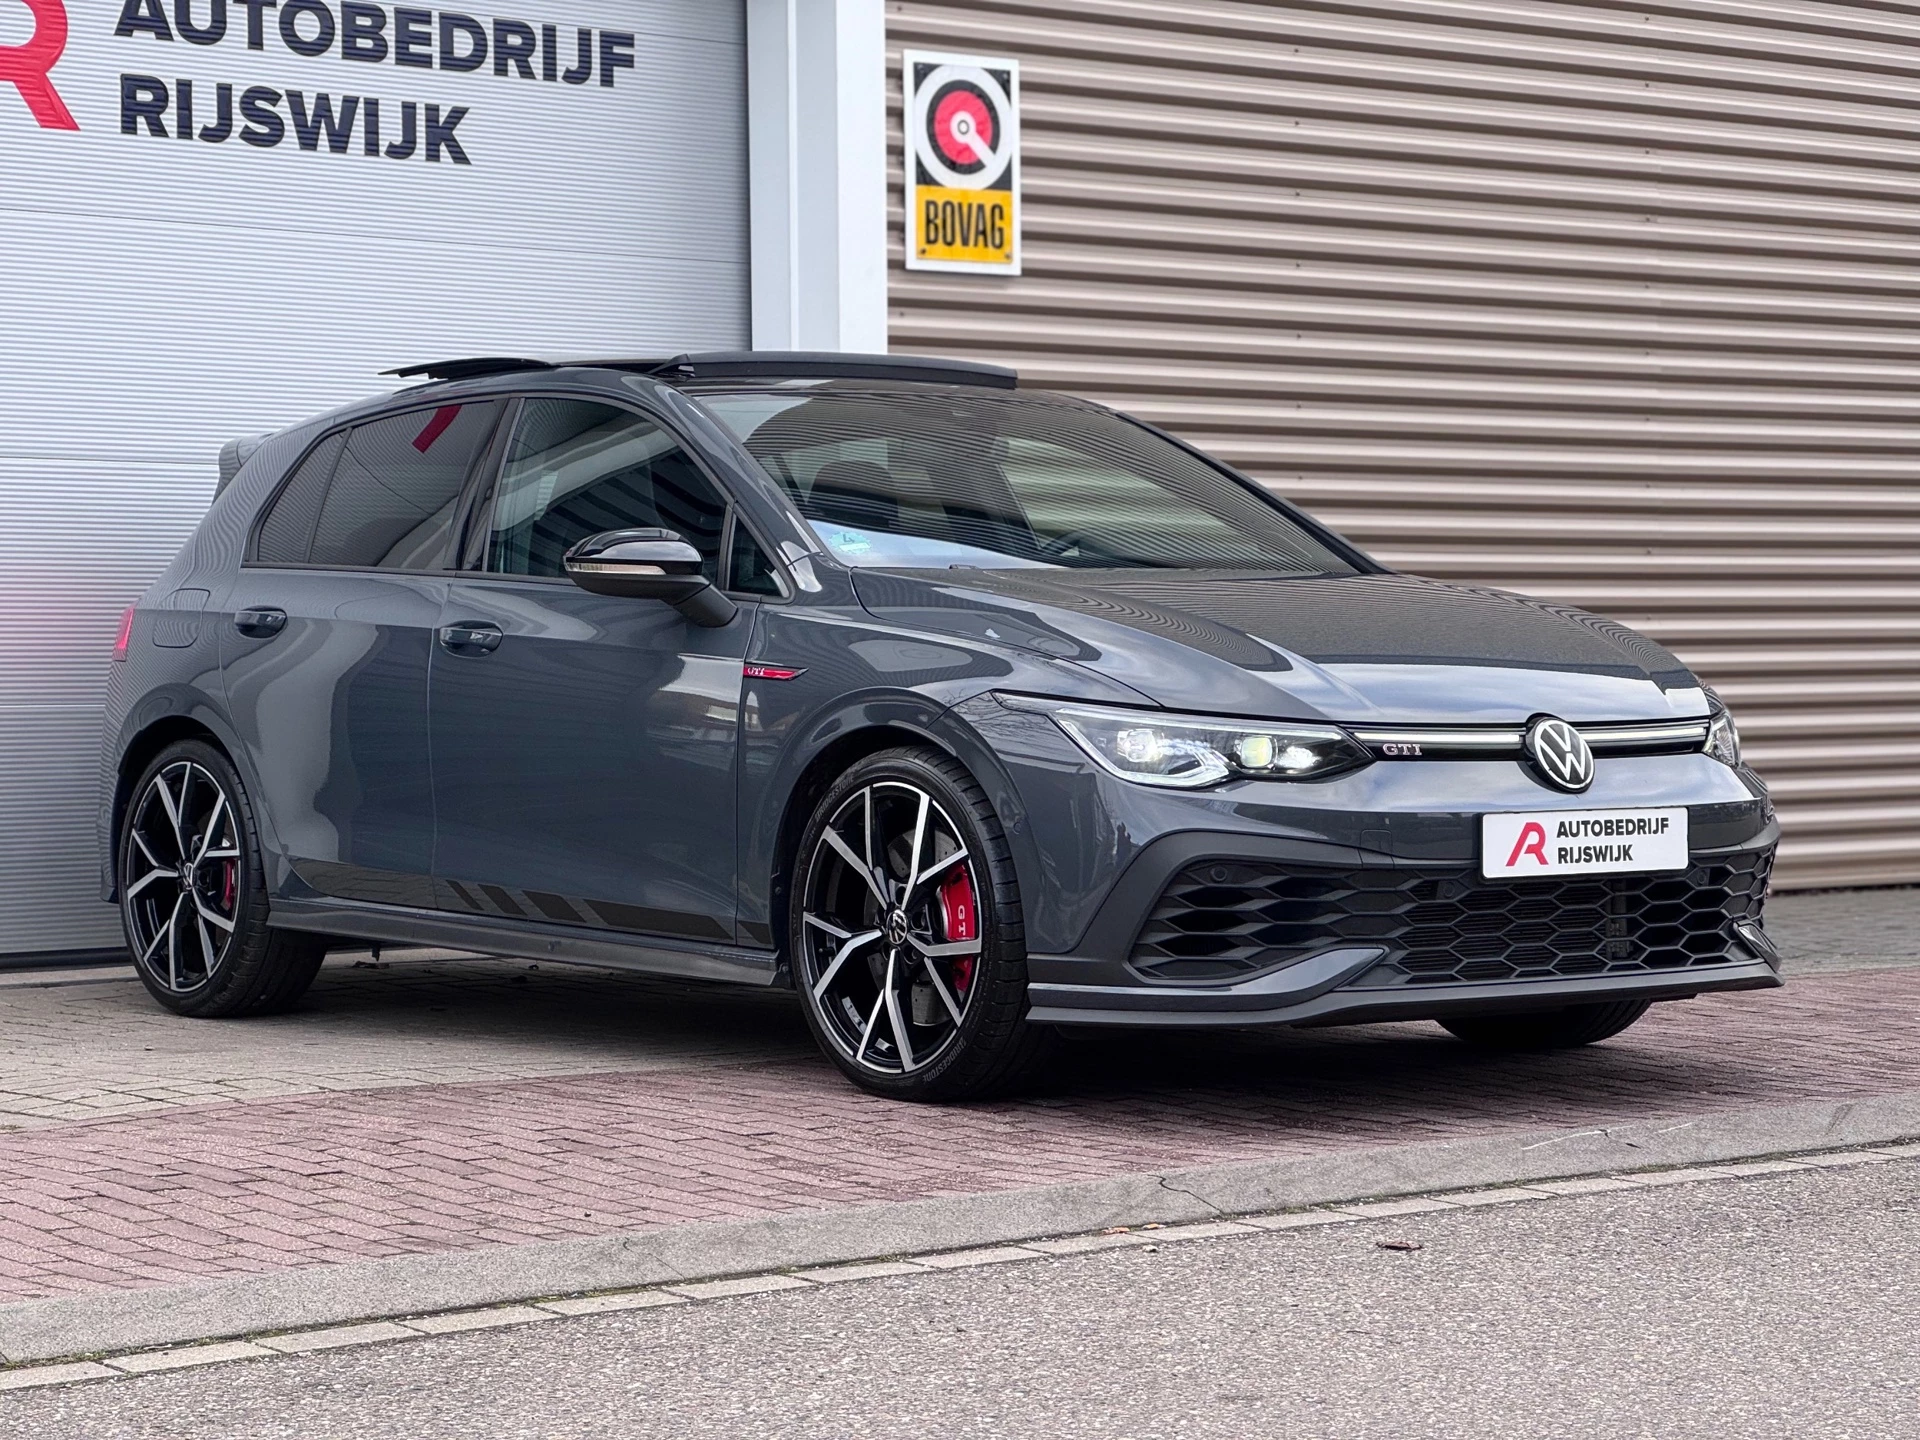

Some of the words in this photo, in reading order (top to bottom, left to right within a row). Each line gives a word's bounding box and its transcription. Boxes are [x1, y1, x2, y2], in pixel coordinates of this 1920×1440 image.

[113, 0, 636, 89] AUTOBEDRIJF
[119, 73, 473, 166] RIJSWIJK
[924, 199, 1005, 249] BOVAG
[1382, 742, 1423, 756] GTI
[1556, 817, 1670, 839] AUTOBEDRIJF
[1557, 843, 1634, 865] RIJSWIJK
